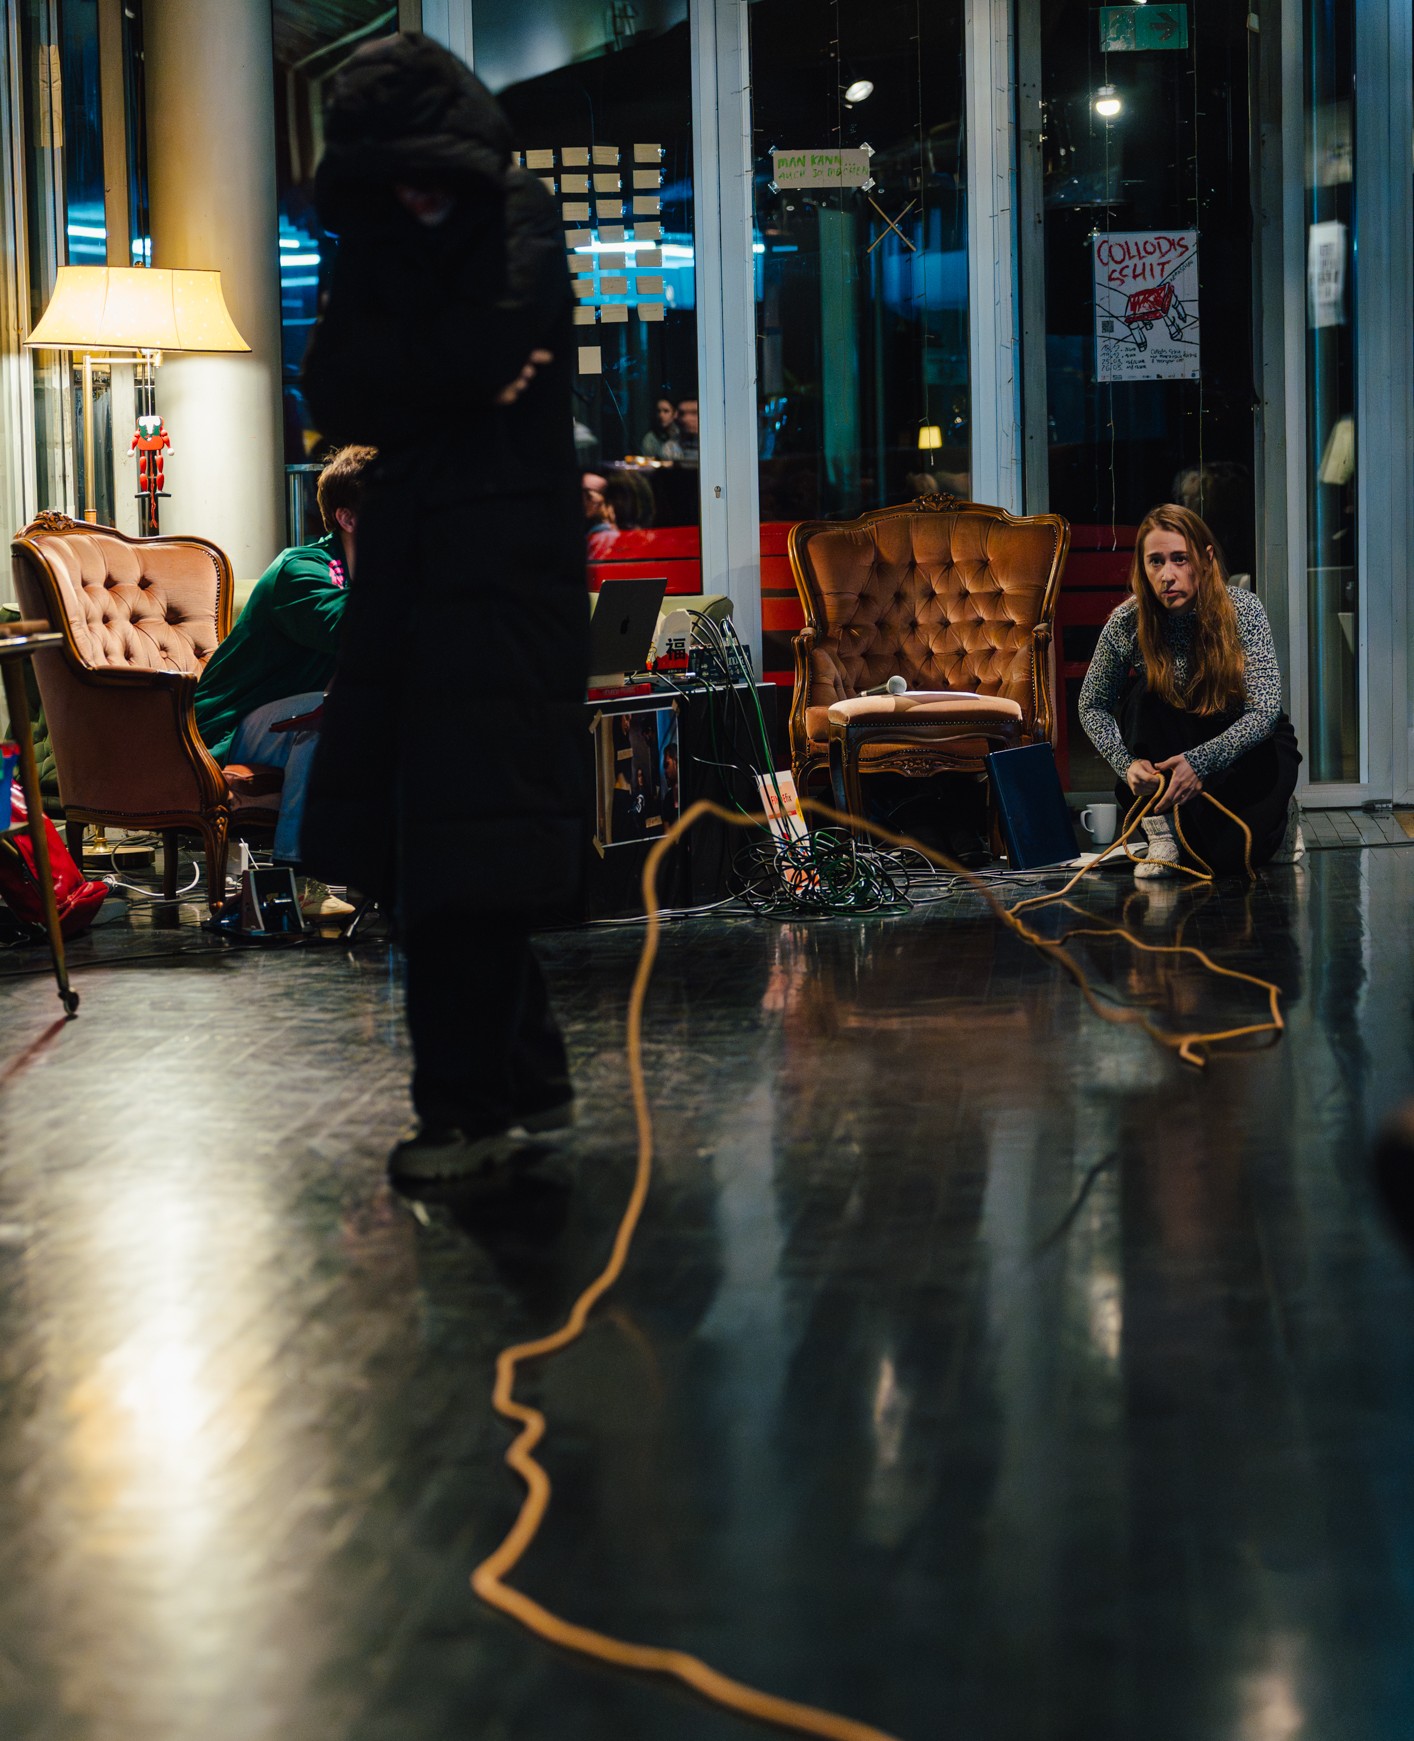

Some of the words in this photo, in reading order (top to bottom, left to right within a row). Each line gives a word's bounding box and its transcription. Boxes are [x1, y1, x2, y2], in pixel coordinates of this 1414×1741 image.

[777, 154, 806, 169] MAN
[1097, 236, 1189, 266] COLLODIS
[666, 638, 686, 660] 福
